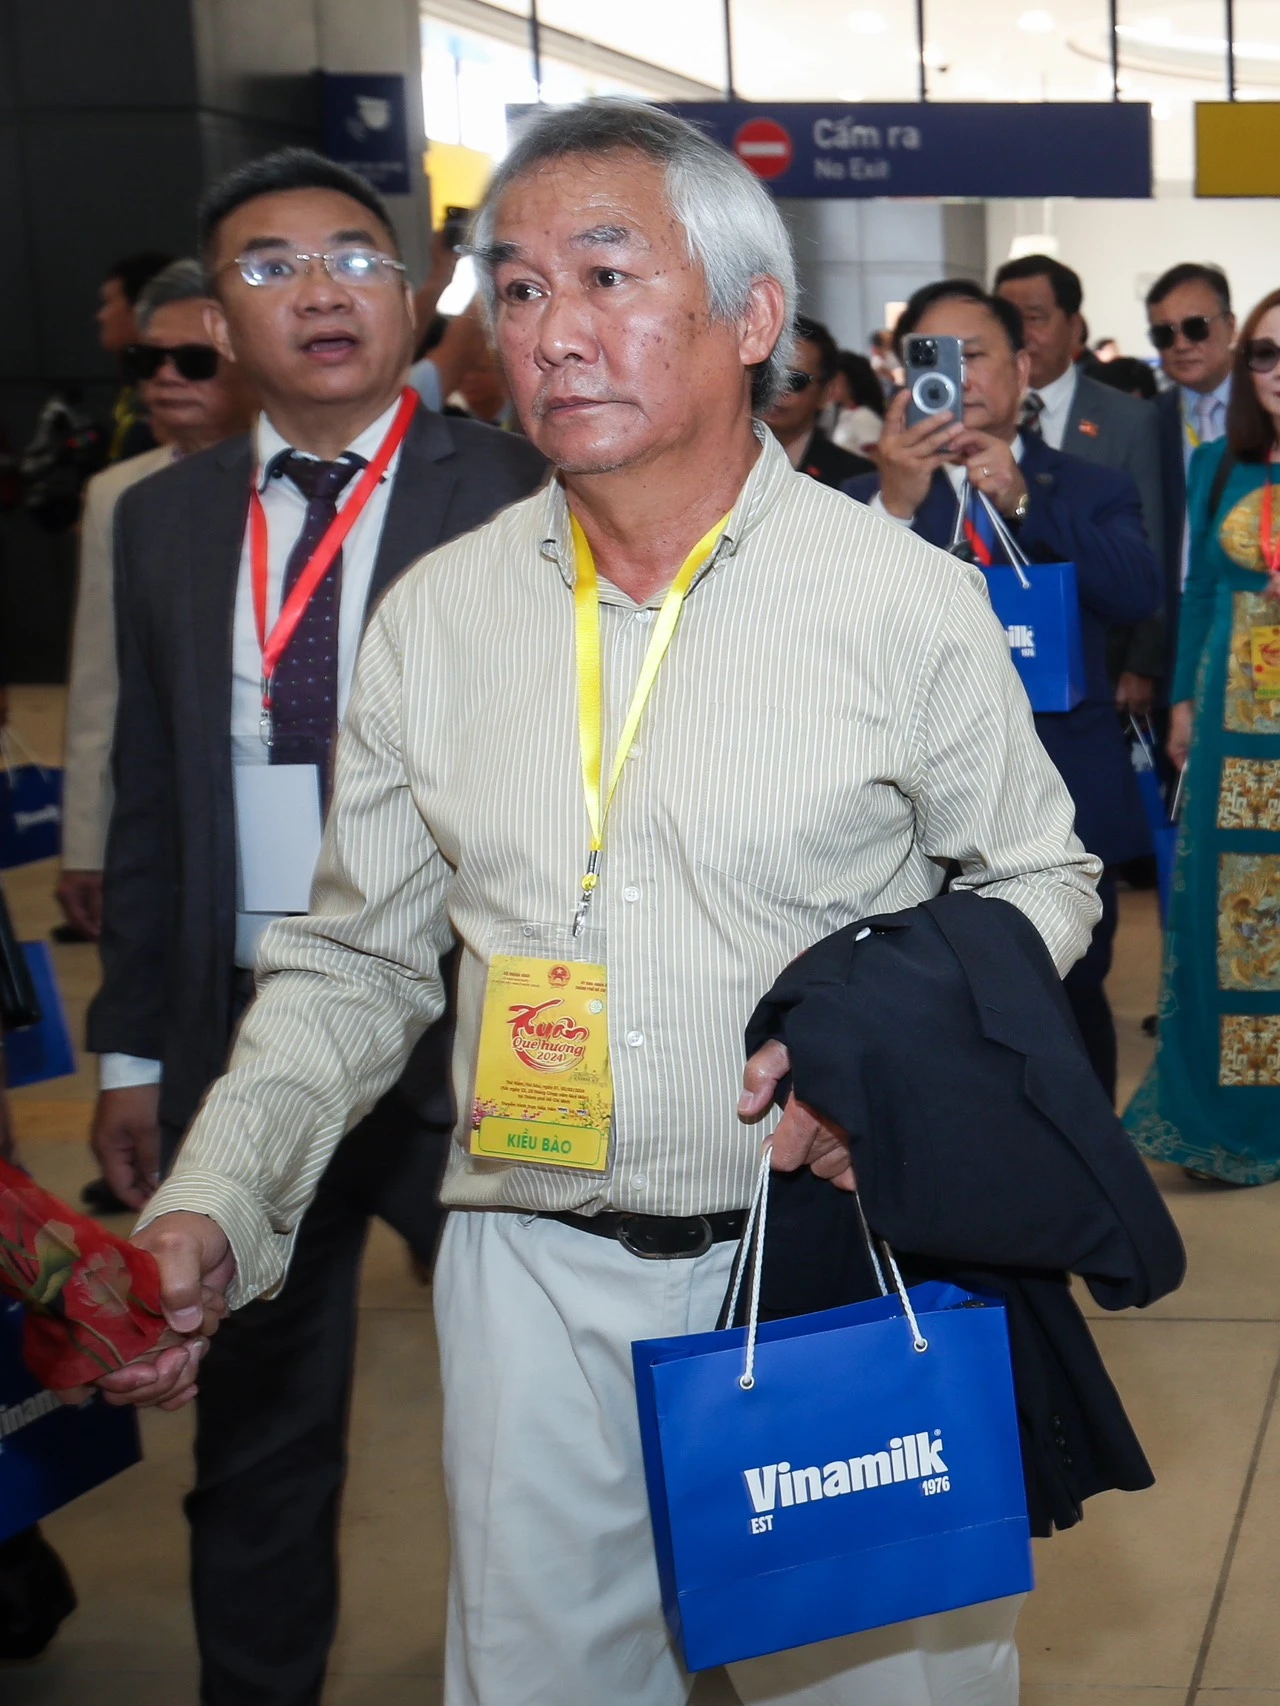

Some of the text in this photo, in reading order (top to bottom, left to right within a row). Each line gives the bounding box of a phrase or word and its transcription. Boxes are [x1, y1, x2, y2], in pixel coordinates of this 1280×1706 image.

[887, 125, 921, 150] ra
[537, 1051, 564, 1062] 2024
[507, 1128, 572, 1154] KIỀU BÀO
[921, 1476, 951, 1496] 1976
[750, 1514, 775, 1535] EST
